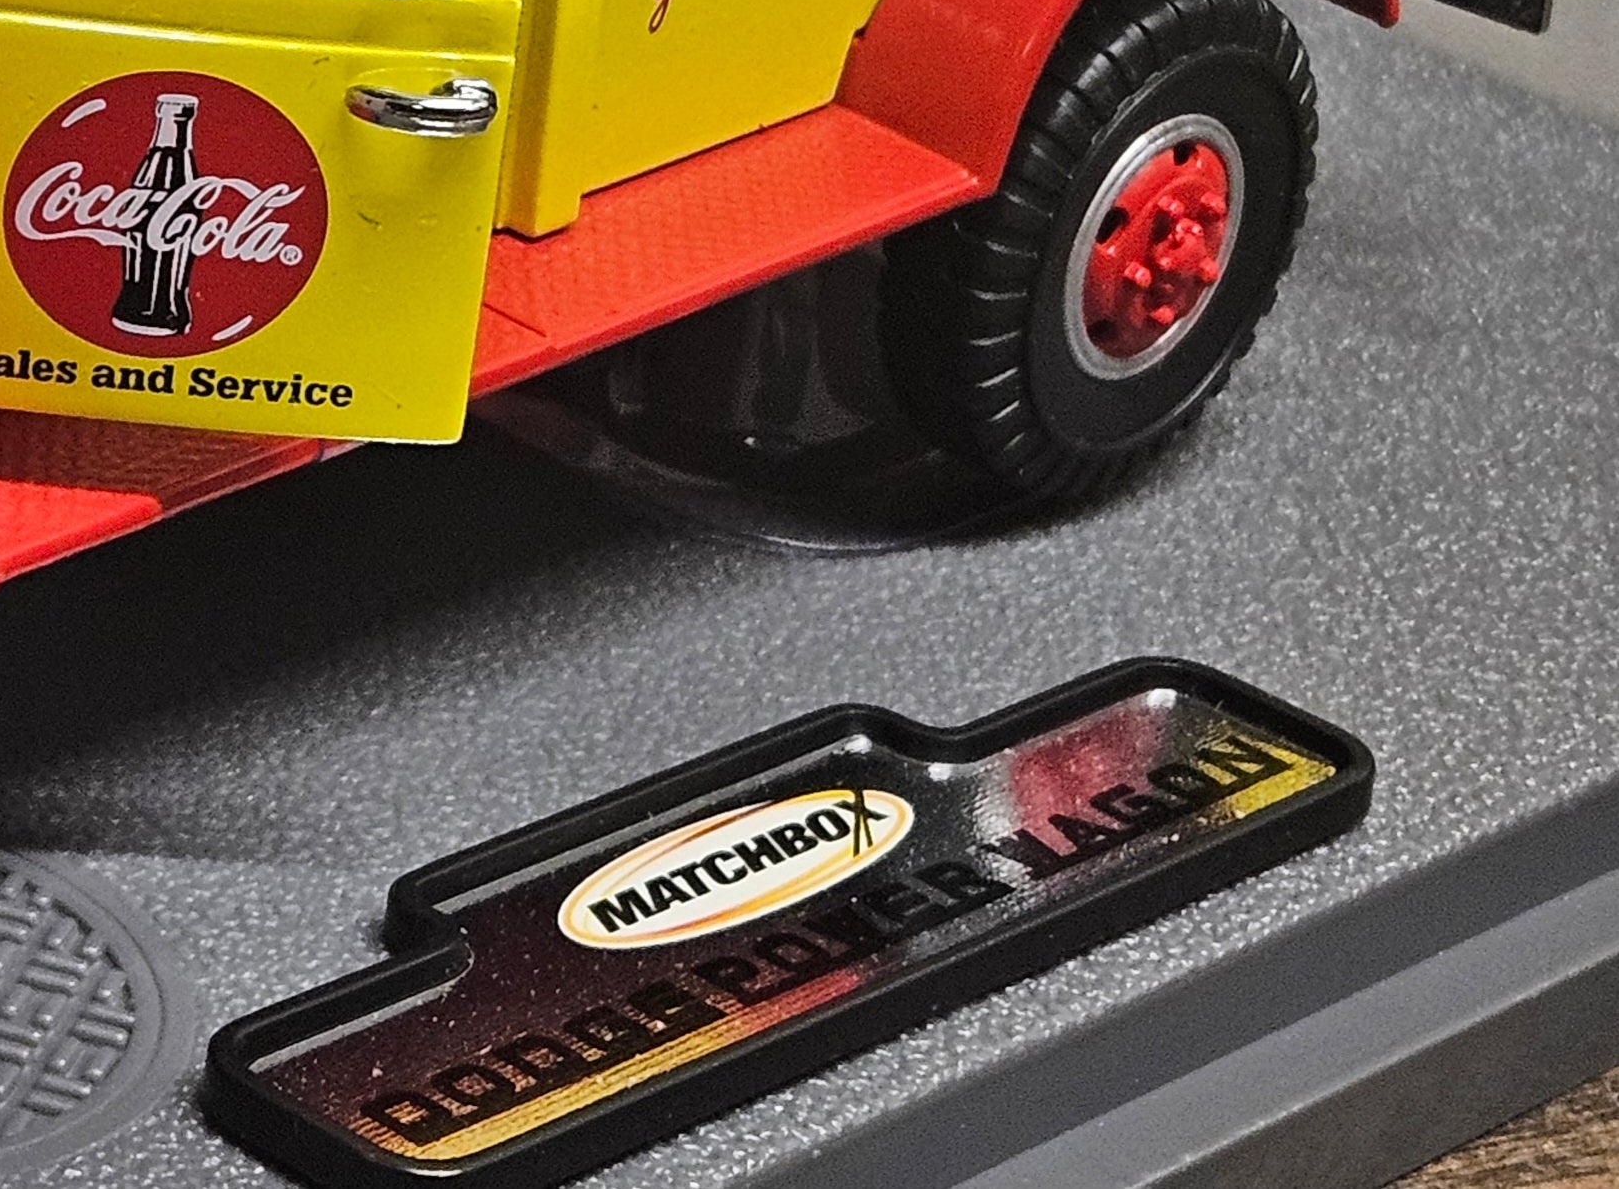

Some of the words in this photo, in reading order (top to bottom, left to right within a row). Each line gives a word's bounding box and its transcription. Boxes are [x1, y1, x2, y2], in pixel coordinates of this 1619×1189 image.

[91, 364, 175, 395] and
[188, 367, 354, 408] Service
[586, 787, 889, 933] MATCHBOX
